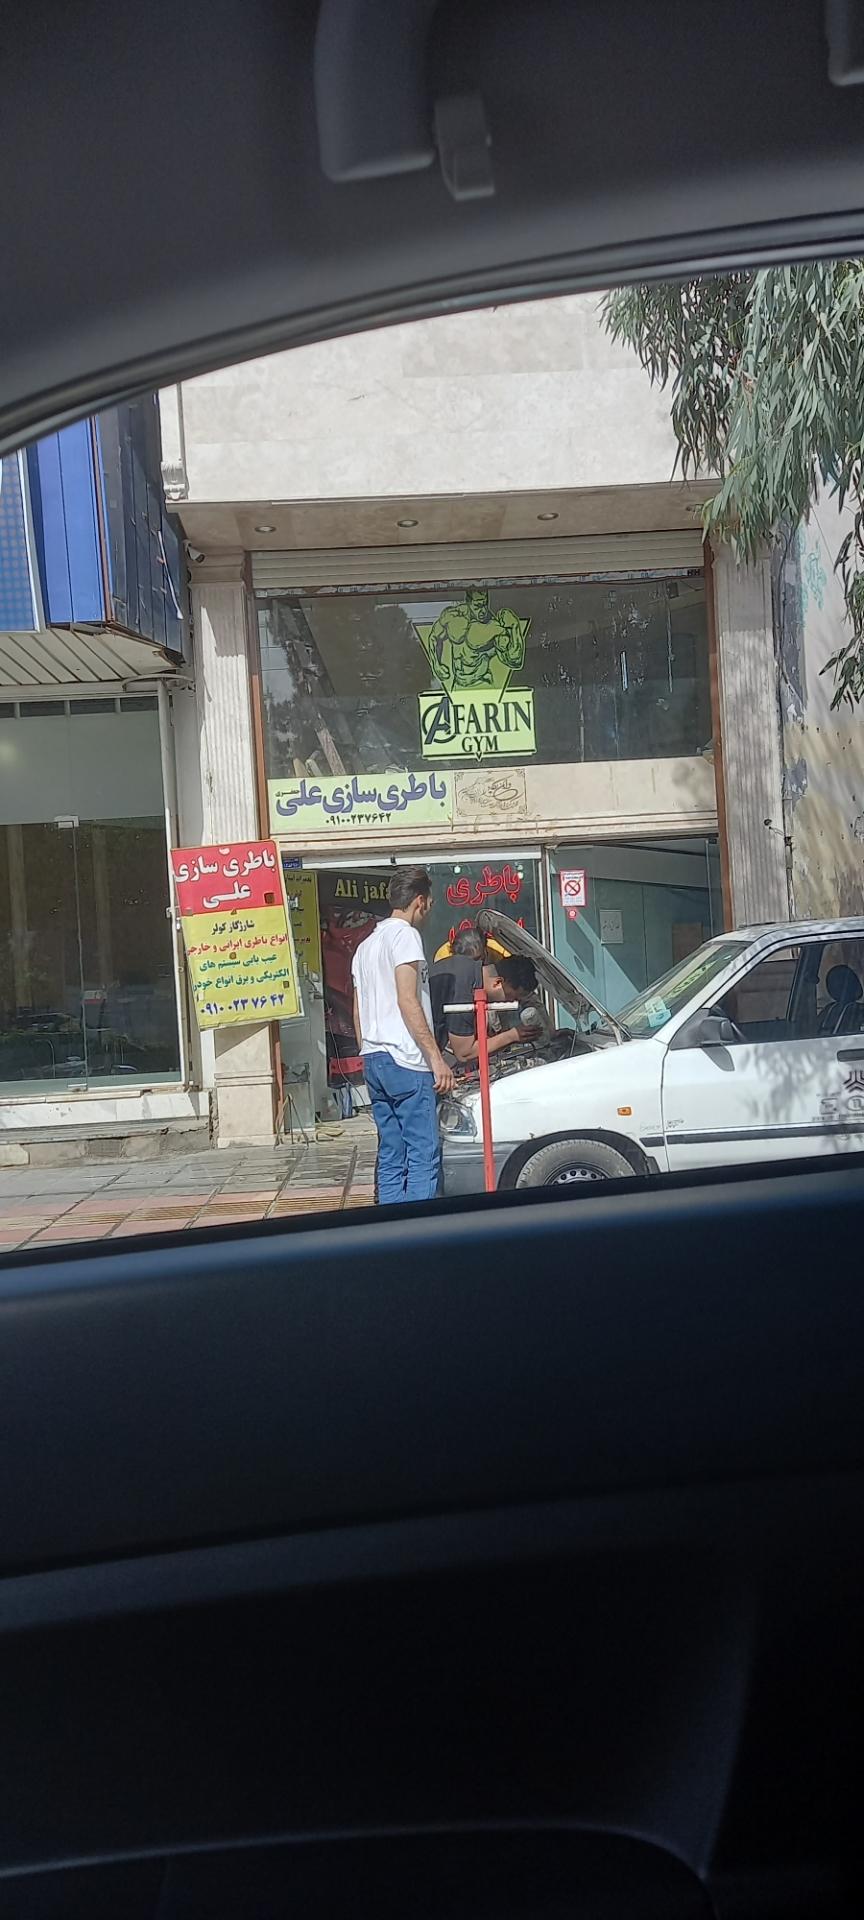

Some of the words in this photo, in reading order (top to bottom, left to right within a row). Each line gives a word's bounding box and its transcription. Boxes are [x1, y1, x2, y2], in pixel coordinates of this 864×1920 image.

[422, 697, 531, 744] AFARIN
[461, 735, 499, 752] GYM
[275, 779, 322, 817] علی
[322, 776, 377, 814] سازی
[377, 772, 447, 811] باطری
[325, 812, 391, 826] ۰۹۱۰۰۲۳۷۶۴۲
[174, 855, 218, 883] سازی
[222, 848, 276, 878] باطری
[334, 878, 359, 898] Ali
[446, 863, 522, 907] باطری
[202, 880, 251, 908] علی
[211, 922, 226, 936] کولر
[220, 938, 242, 952] ایرانی
[244, 936, 267, 949] باطری
[269, 933, 288, 946] انواع
[199, 960, 215, 971] های
[217, 959, 240, 969] سیستم
[261, 954, 277, 965] عیب
[215, 976, 233, 988] انواع
[235, 974, 248, 985] برق
[256, 968, 289, 982] الکتریکی
[201, 1002, 224, 1015] ۰۹۱۰
[228, 998, 248, 1011] ۰۲۳
[251, 996, 267, 1008] ۷۶
[270, 993, 284, 1006] ۴۲
